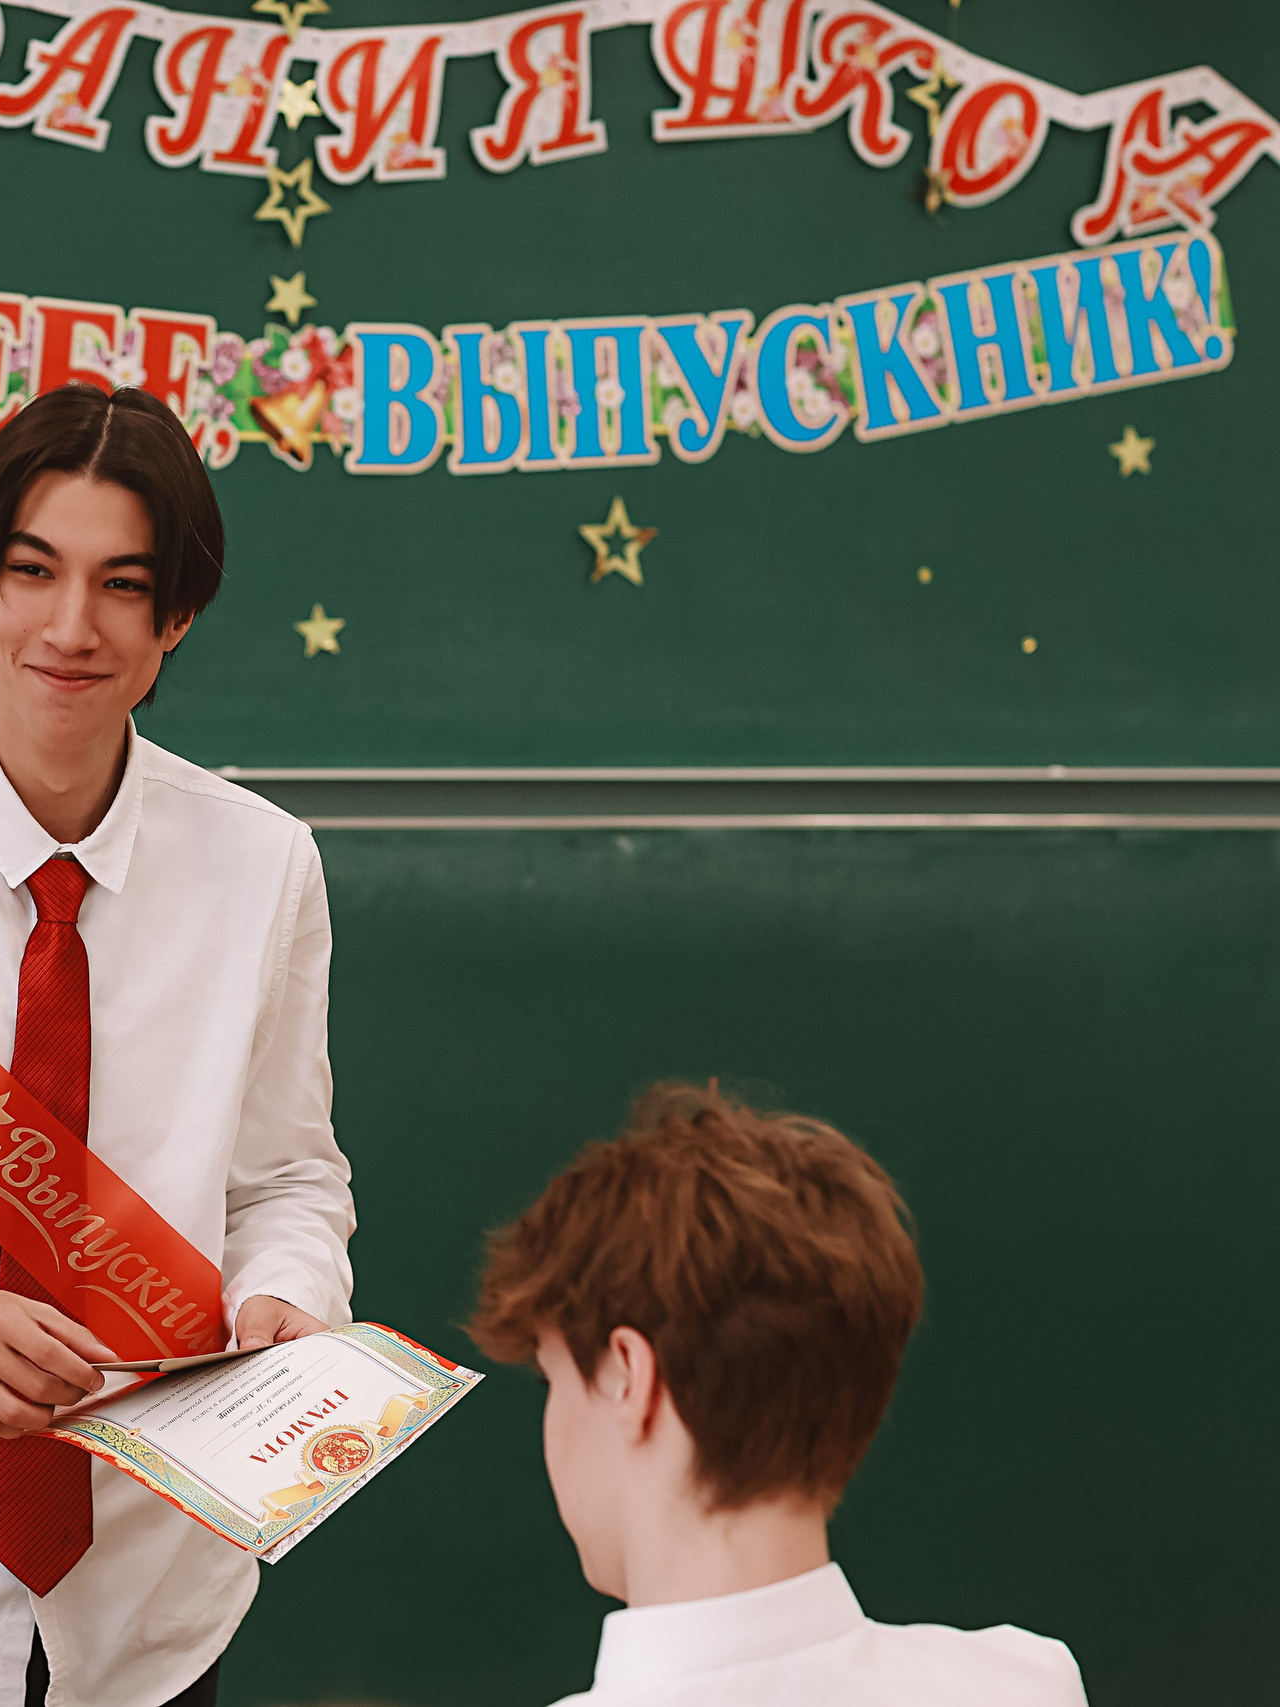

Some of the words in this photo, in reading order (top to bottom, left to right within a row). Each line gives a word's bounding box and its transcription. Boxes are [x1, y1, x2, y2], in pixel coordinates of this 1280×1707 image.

[662, 0, 1272, 237] ШКОЛА
[356, 239, 1222, 465] ВЫПУСКНИК!
[249, 1388, 350, 1464] ГРАМОТА
[257, 1391, 303, 1428] НАГРАЖДАЕТСЯ
